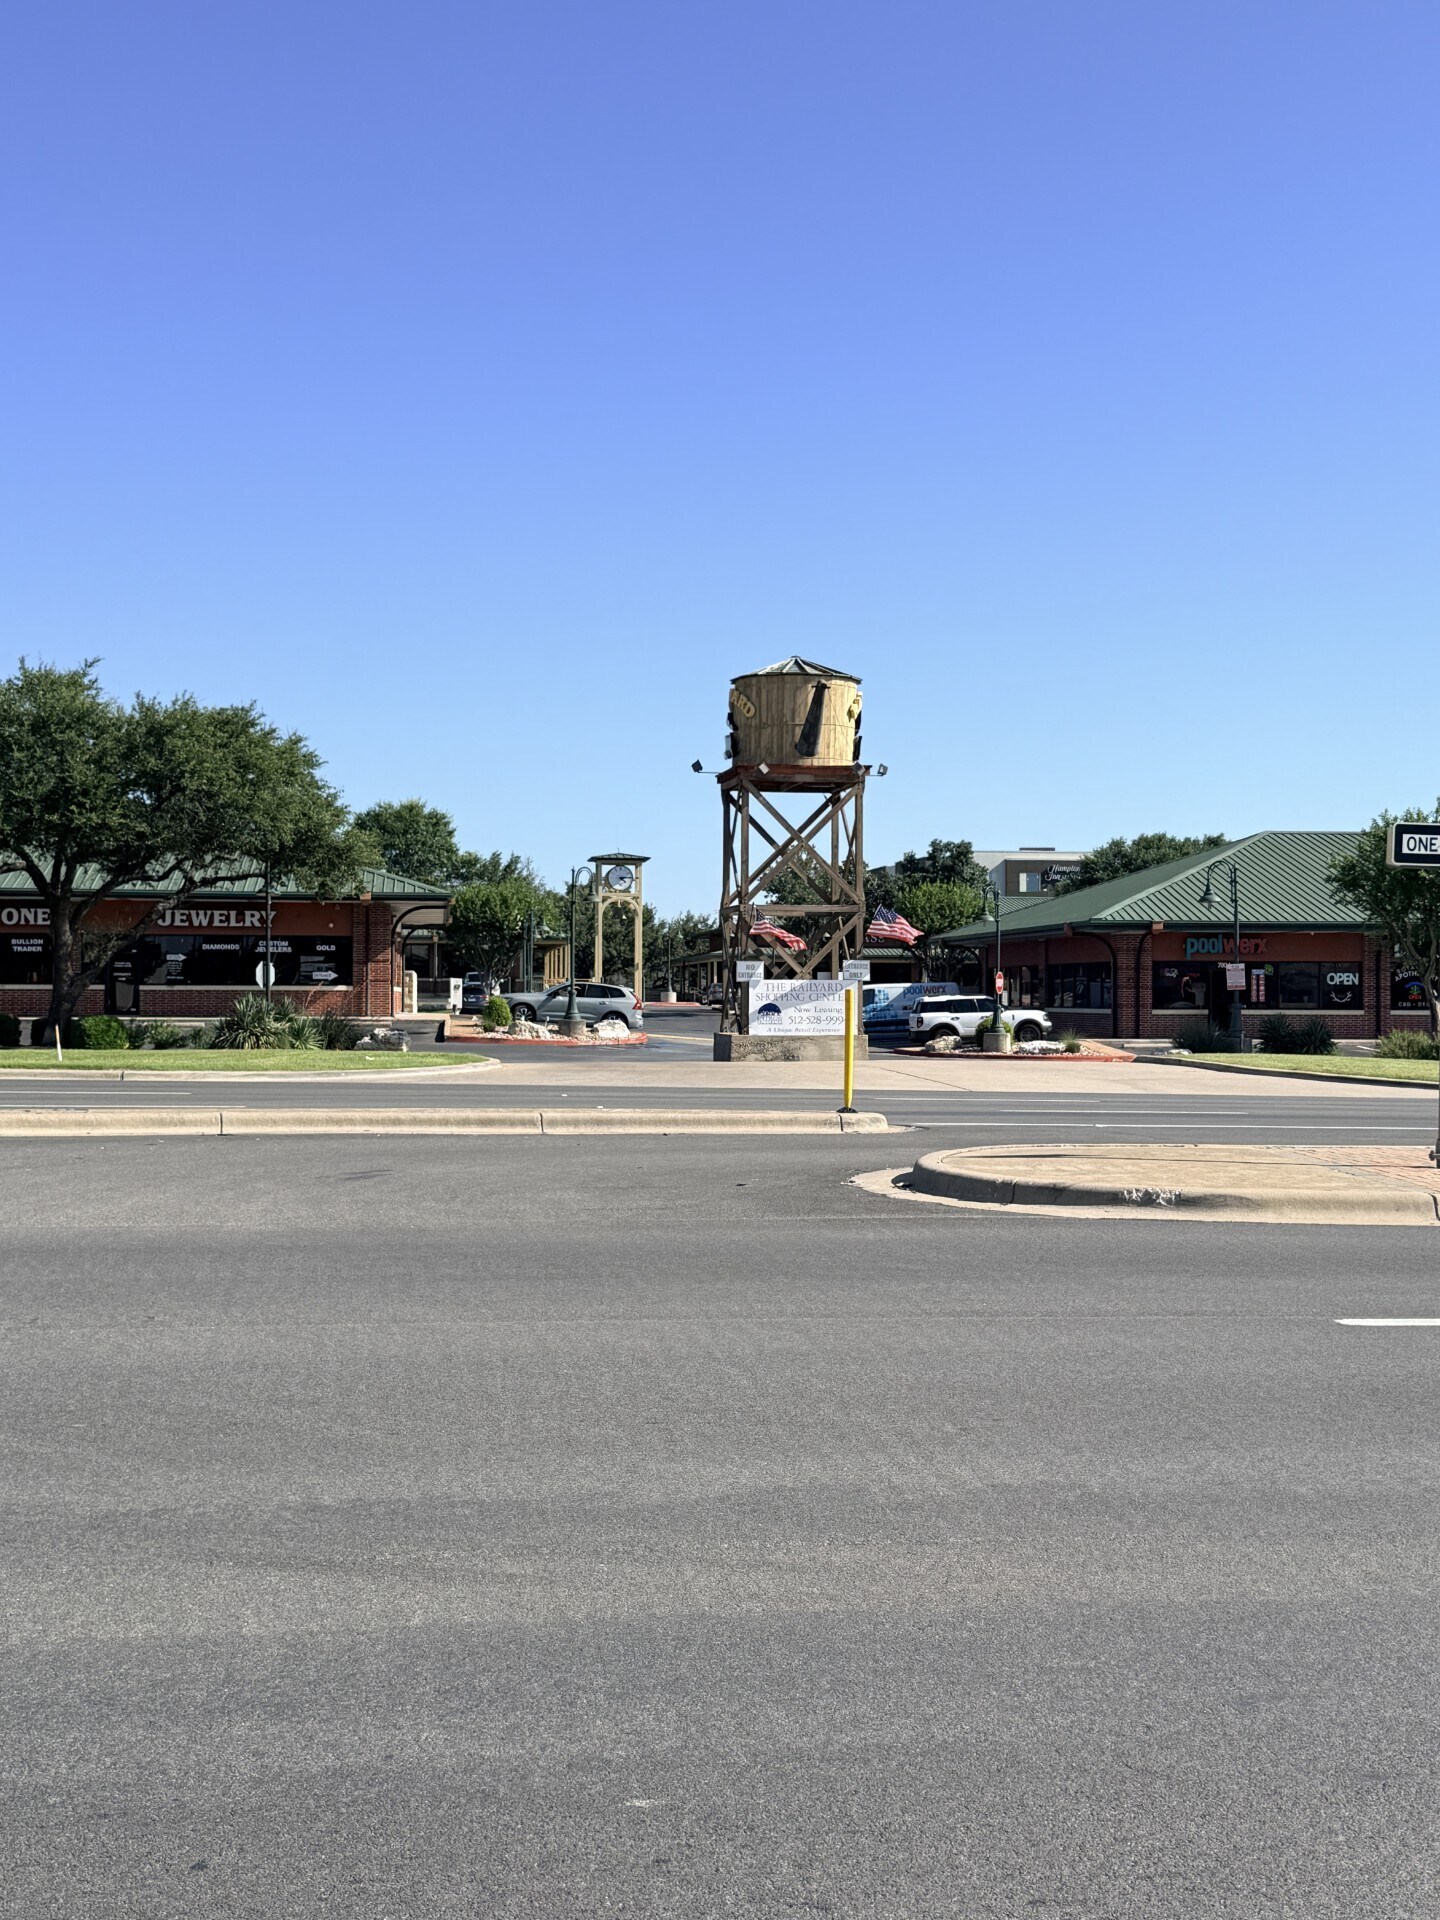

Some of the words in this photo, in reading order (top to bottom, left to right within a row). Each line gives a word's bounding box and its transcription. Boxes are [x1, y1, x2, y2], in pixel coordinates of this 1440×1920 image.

[1407, 836, 1438, 852] ONE
[0, 907, 51, 925] ONE
[157, 909, 277, 928] JEWELRY
[1186, 934, 1267, 960] poolwerx
[745, 963, 756, 971] NO
[1326, 973, 1359, 985] OPEN
[764, 982, 786, 992] THE
[790, 982, 843, 992] RAILYARD
[903, 984, 947, 998] poolwerx
[755, 993, 805, 1002] SHOPPING
[809, 993, 844, 1002] CENTE
[788, 1015, 844, 1025] 512-528-999
